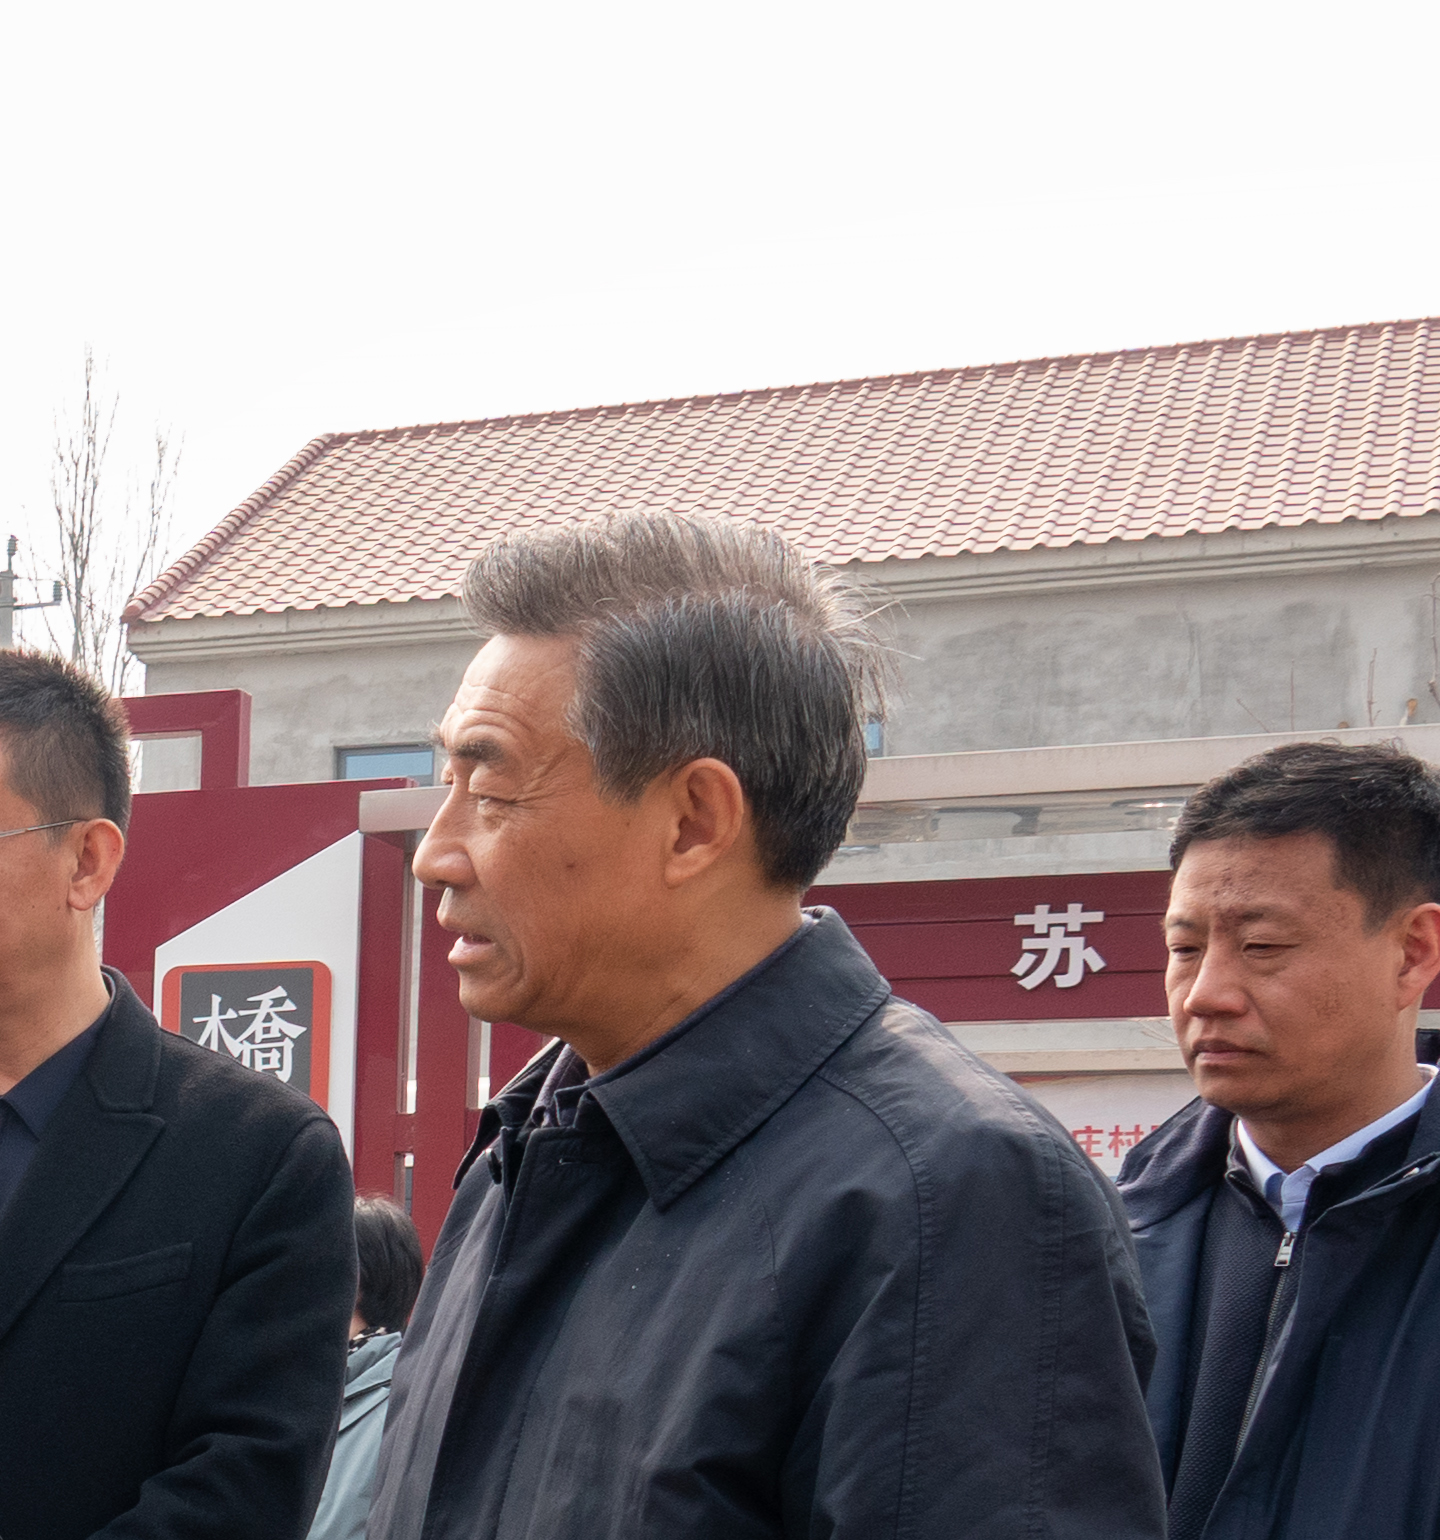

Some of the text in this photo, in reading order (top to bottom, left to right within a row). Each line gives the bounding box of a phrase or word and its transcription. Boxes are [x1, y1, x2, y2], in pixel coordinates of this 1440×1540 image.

[1010, 902, 1107, 991] 苏
[192, 985, 308, 1083] 橋
[1071, 1124, 1161, 1158] 庄村
